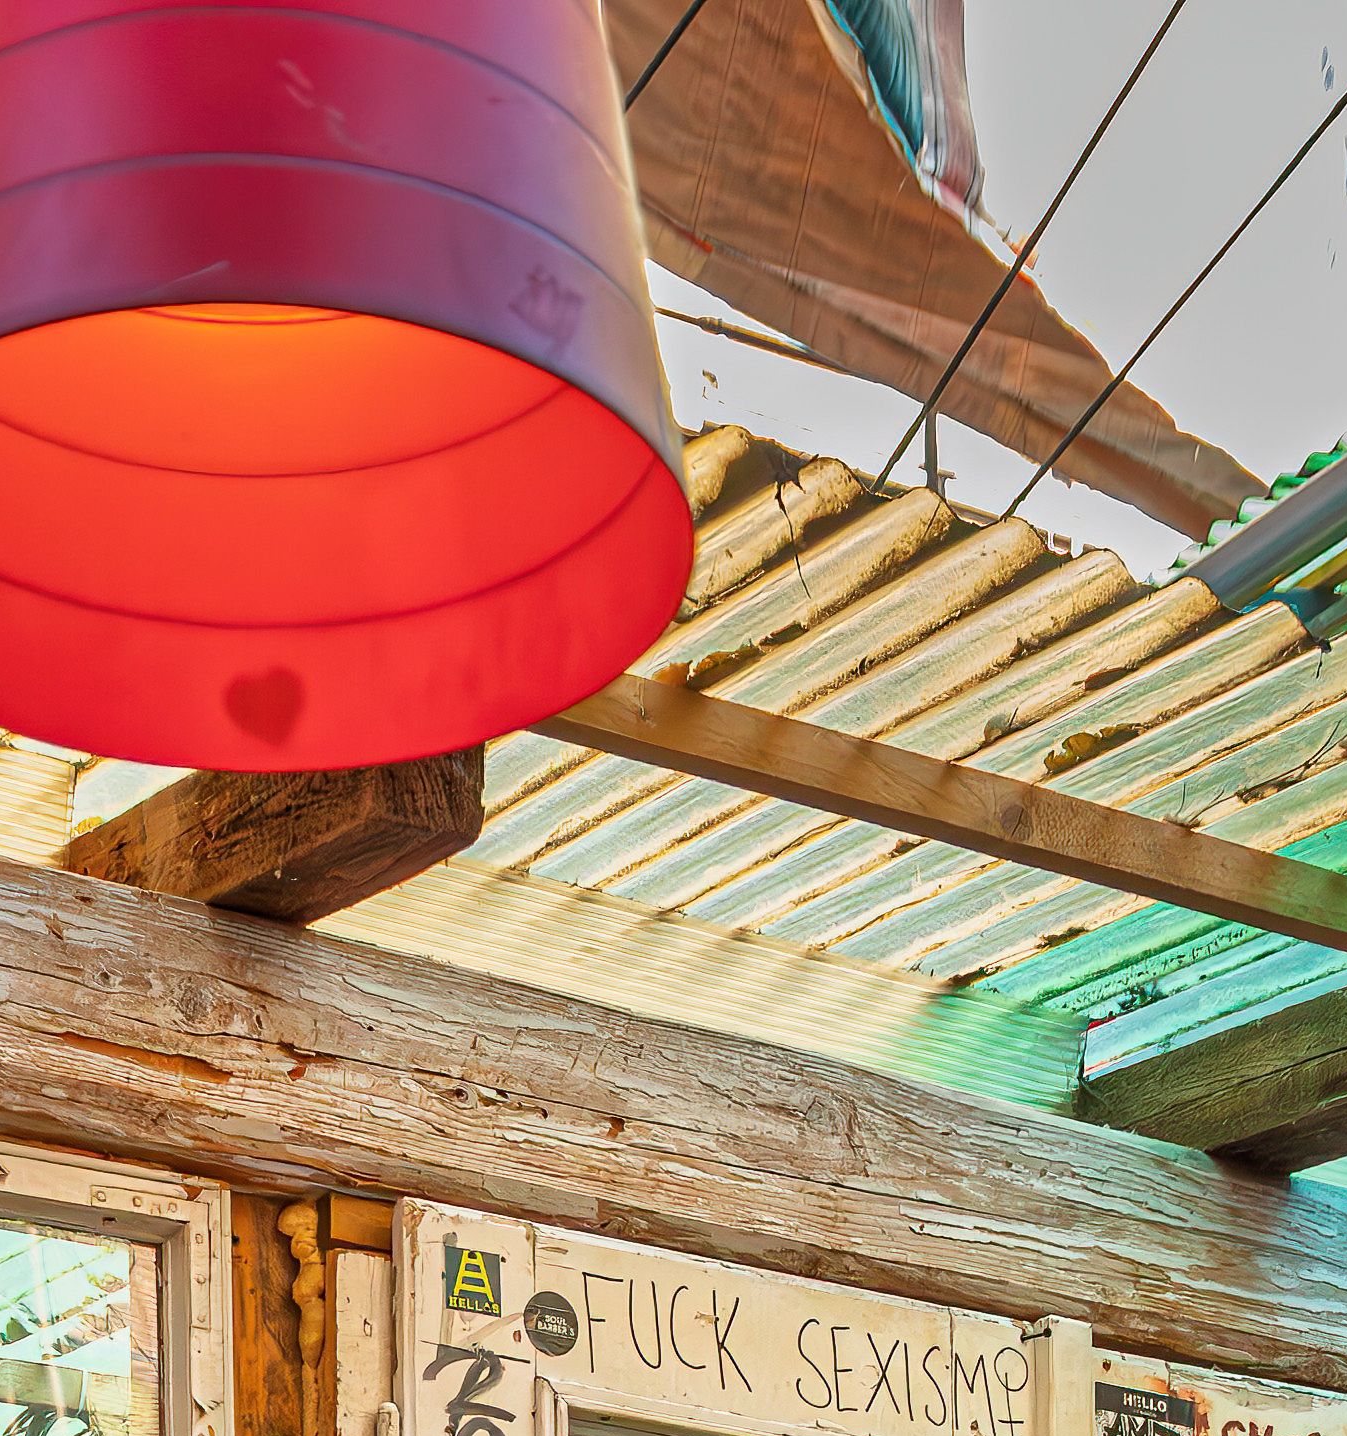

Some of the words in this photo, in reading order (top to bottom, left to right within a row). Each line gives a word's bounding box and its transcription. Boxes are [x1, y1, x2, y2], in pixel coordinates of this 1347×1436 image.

[583, 1271, 752, 1393] FUCK
[796, 1318, 992, 1431] SEXISM
[1123, 1393, 1167, 1413] HELLO
